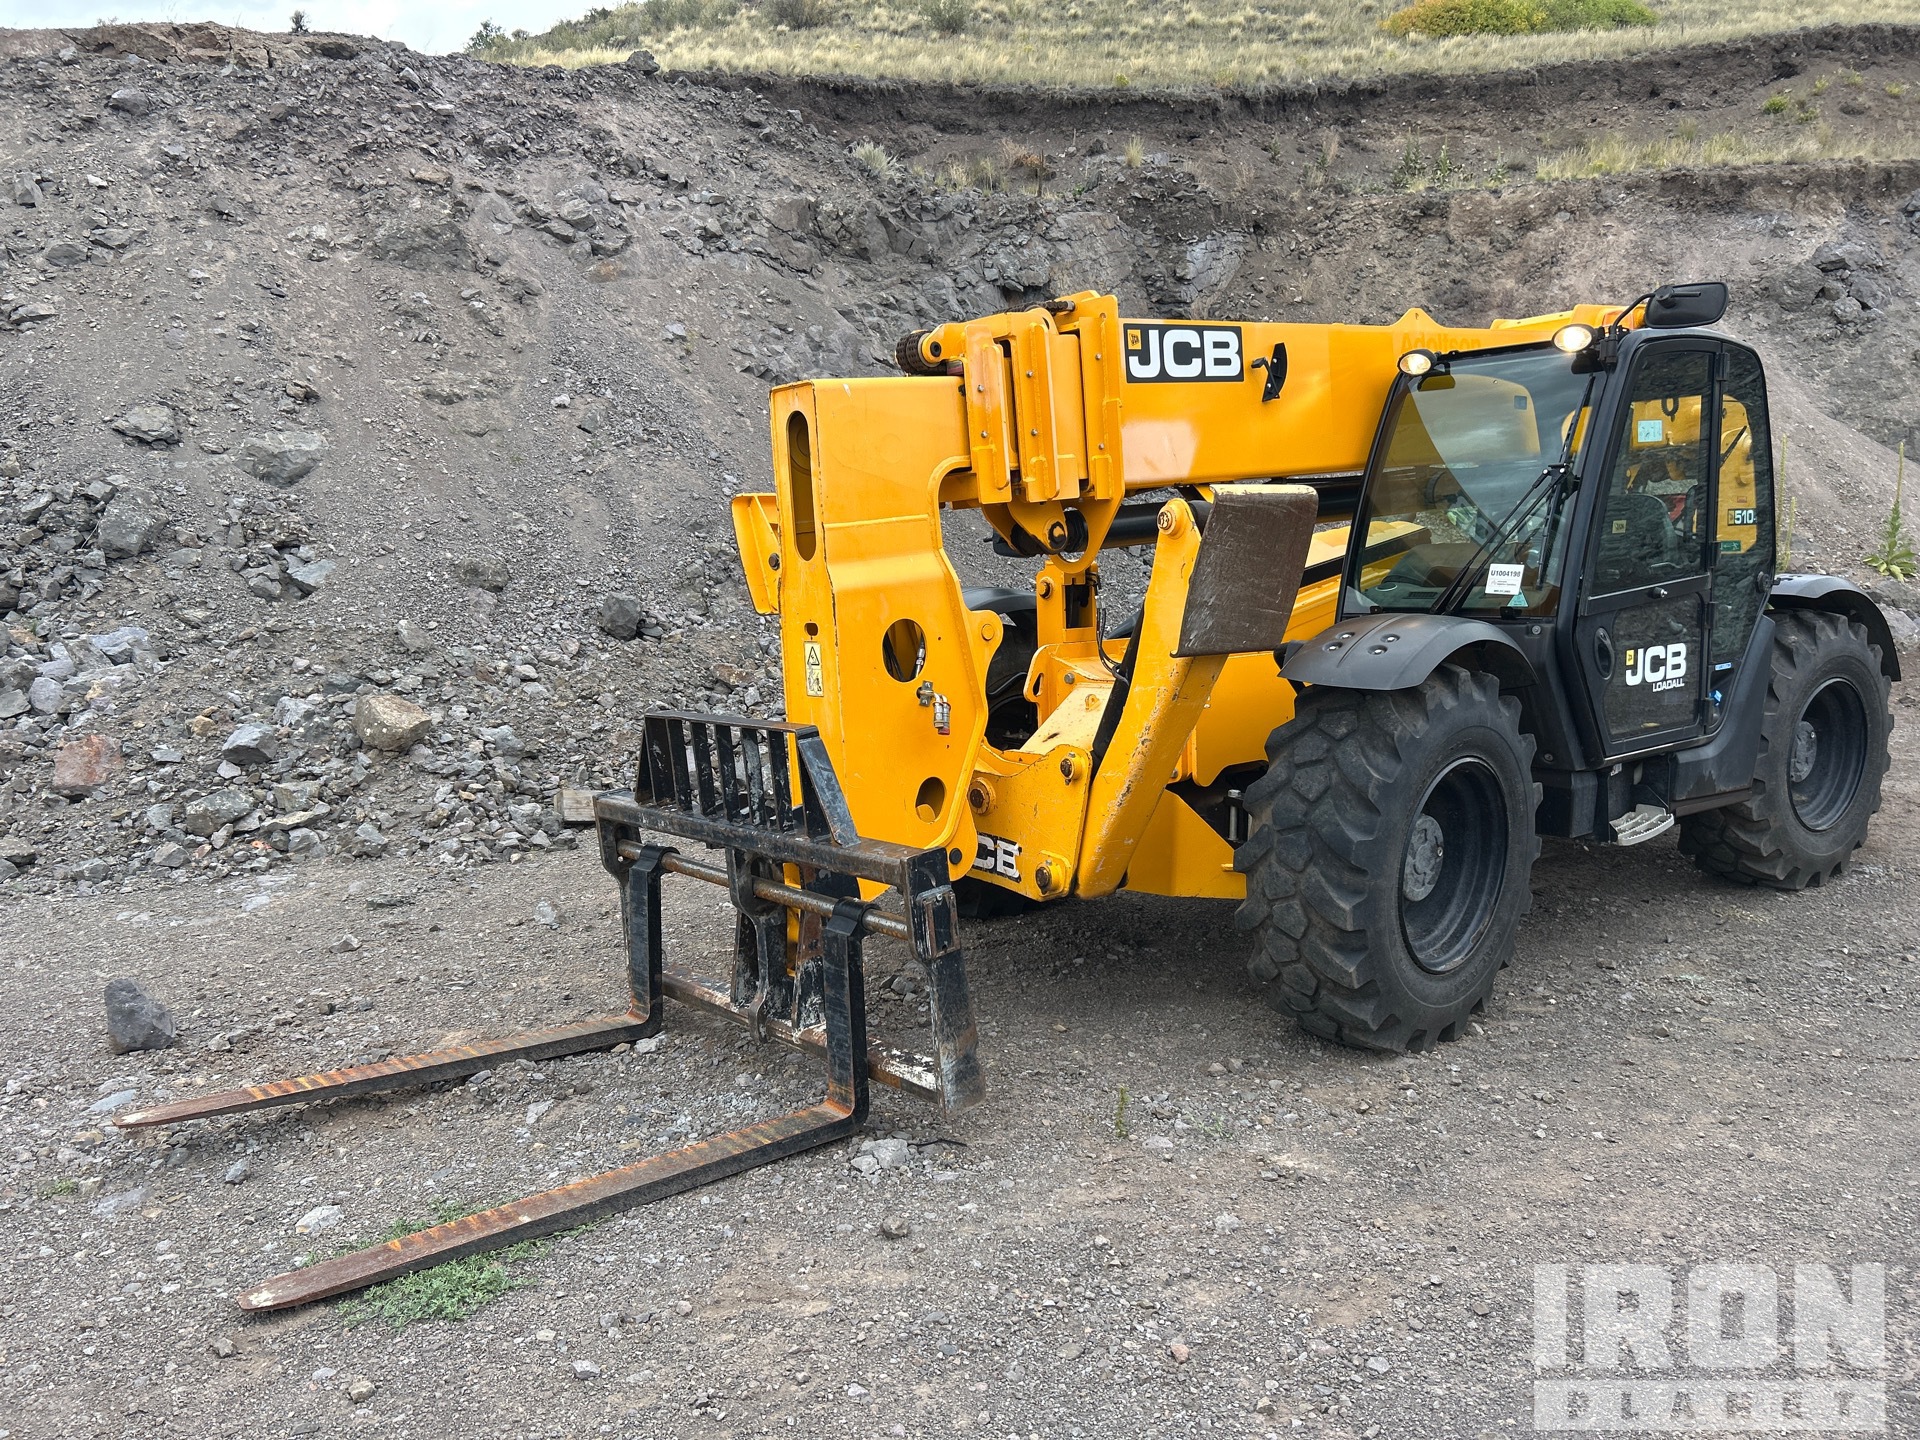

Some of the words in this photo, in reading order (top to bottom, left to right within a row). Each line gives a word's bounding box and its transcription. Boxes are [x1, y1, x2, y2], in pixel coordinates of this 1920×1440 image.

[1128, 329, 1241, 378] JCB
[1626, 643, 1686, 686] JCB
[1652, 678, 1685, 692] LOADALL
[973, 835, 1020, 878] CB
